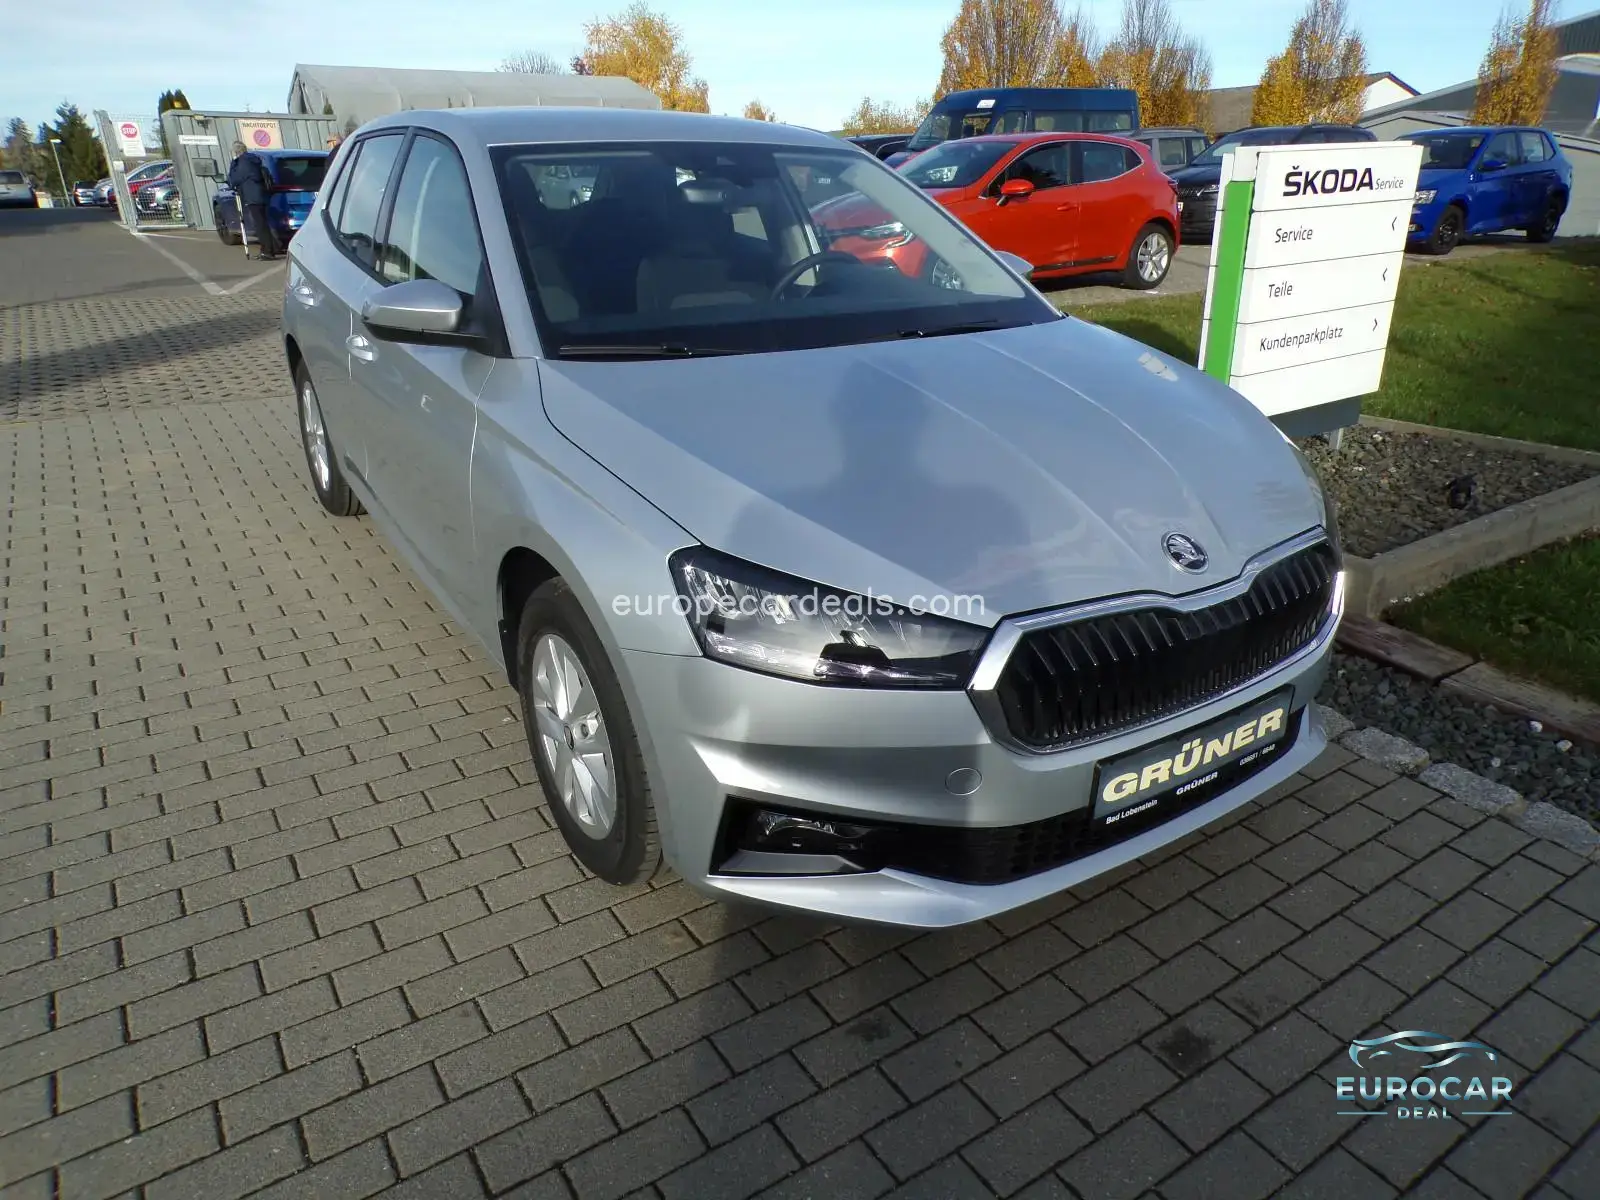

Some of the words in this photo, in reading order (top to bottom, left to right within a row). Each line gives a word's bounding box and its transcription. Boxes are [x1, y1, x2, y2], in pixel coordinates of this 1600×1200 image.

[1283, 165, 1374, 197] ŠKODA
[1375, 177, 1404, 190] Service
[1275, 227, 1314, 243] Service
[1268, 282, 1293, 298] Teile
[1259, 326, 1344, 352] Kundenparkplatz
[1102, 707, 1284, 802] GRÜNER
[1176, 771, 1218, 796] GRÜNER
[1106, 812, 1121, 825] Bad
[1120, 799, 1158, 819] Lobenstein
